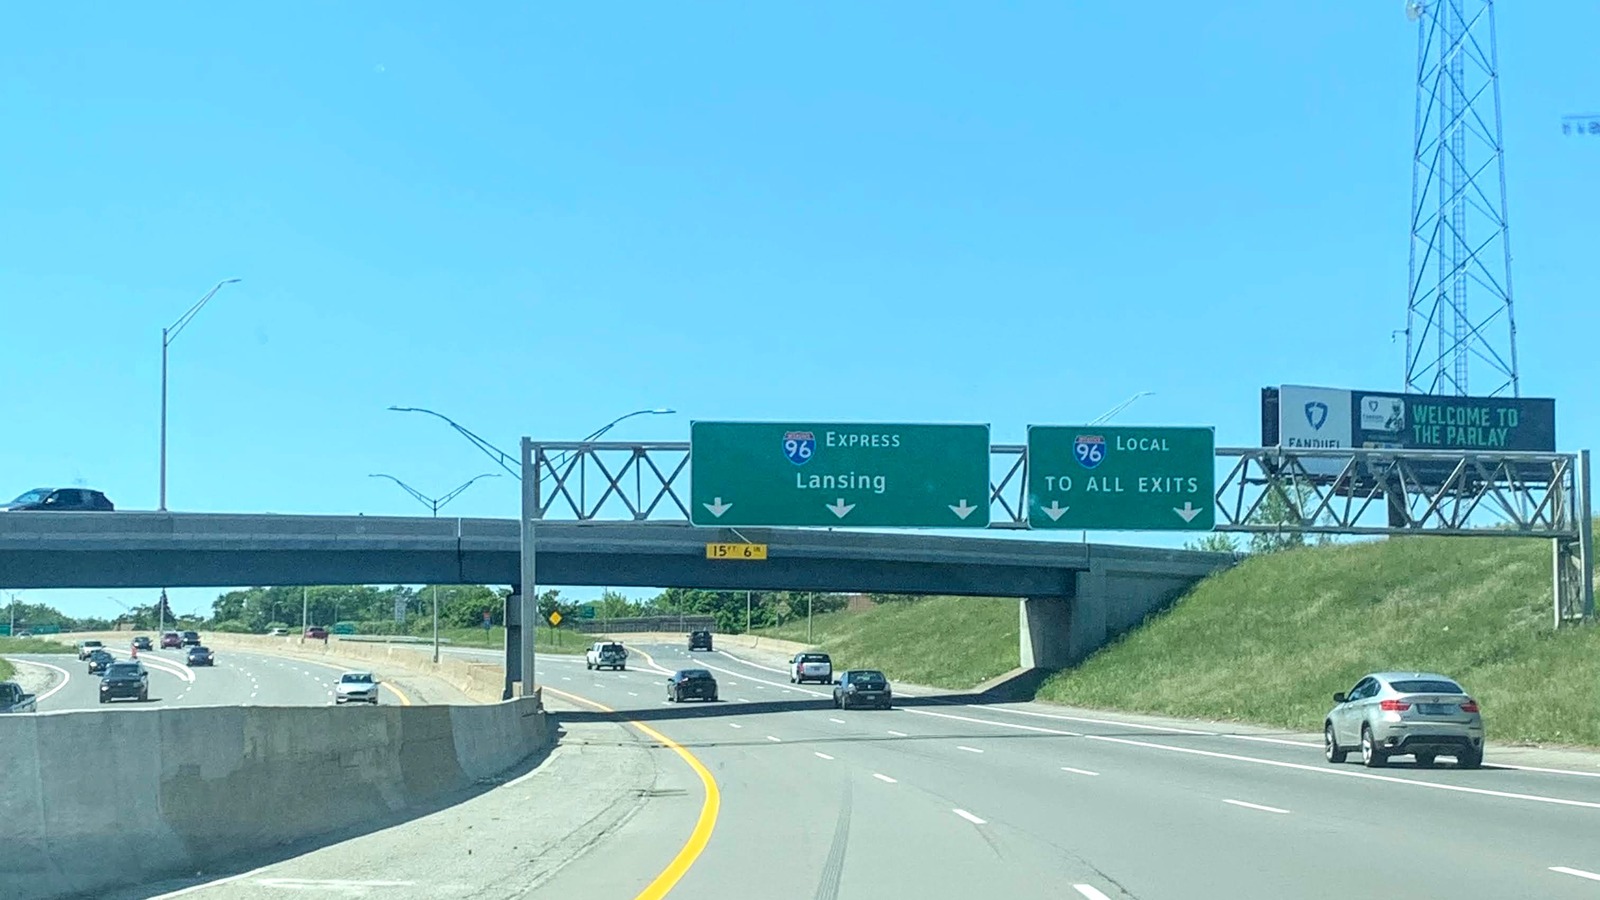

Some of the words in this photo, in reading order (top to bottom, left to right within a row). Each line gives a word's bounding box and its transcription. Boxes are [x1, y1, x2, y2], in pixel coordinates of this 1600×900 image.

[1412, 404, 1490, 427] WELCOME
[1497, 407, 1518, 428] TO
[785, 440, 811, 459] 96
[826, 431, 901, 448] EXPRESS
[1413, 425, 1440, 445] THE
[1447, 426, 1509, 447] PARLAY
[1076, 443, 1102, 462] 96
[1116, 436, 1170, 451] LOCAL
[797, 472, 886, 494] Lansing
[1045, 476, 1072, 491] TO
[1086, 477, 1124, 492] ALL
[1138, 477, 1198, 493] EXITS
